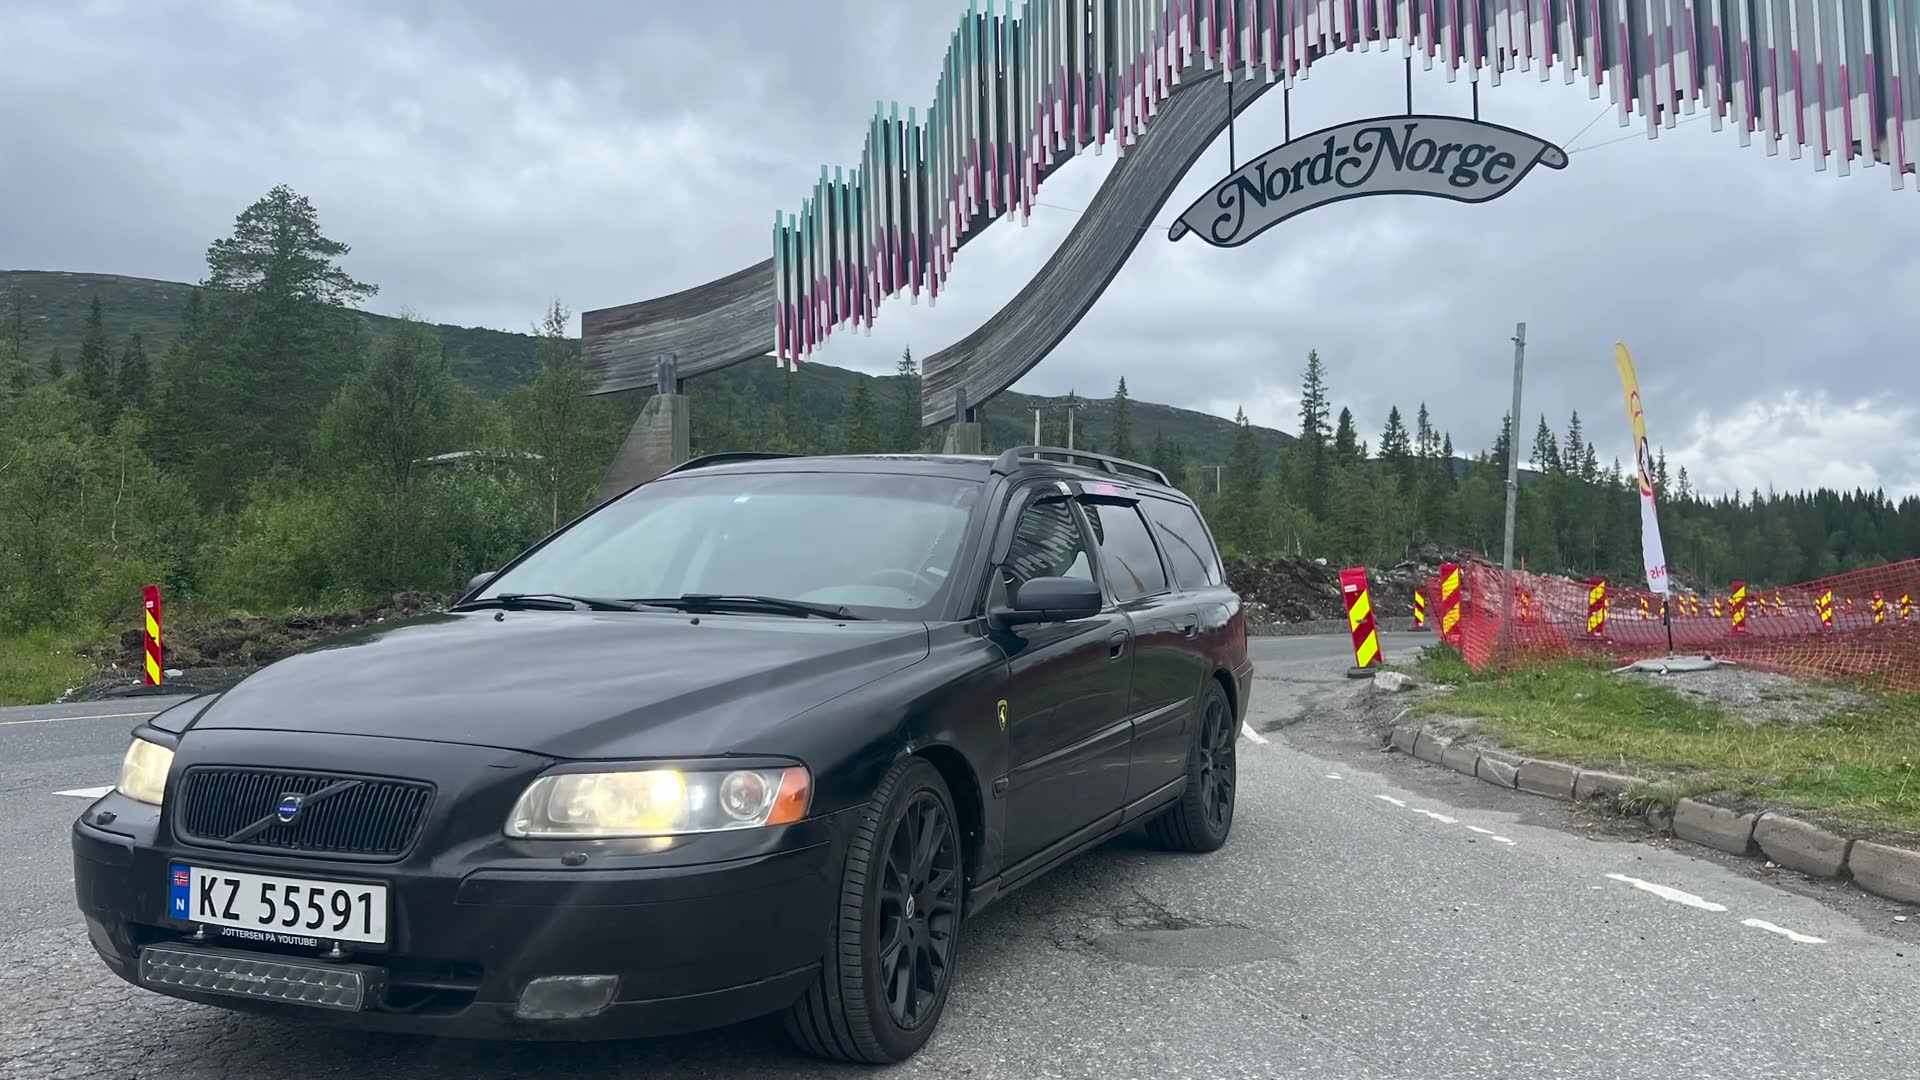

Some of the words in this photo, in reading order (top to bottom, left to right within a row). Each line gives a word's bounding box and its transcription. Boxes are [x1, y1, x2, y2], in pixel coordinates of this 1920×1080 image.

[1211, 123, 1516, 243] Nord-Norge
[176, 898, 185, 911] N
[199, 875, 241, 921] KZ
[258, 882, 372, 935] 55591
[221, 927, 264, 941] JOTTERSEN
[278, 935, 318, 947] YOUTUBE!
